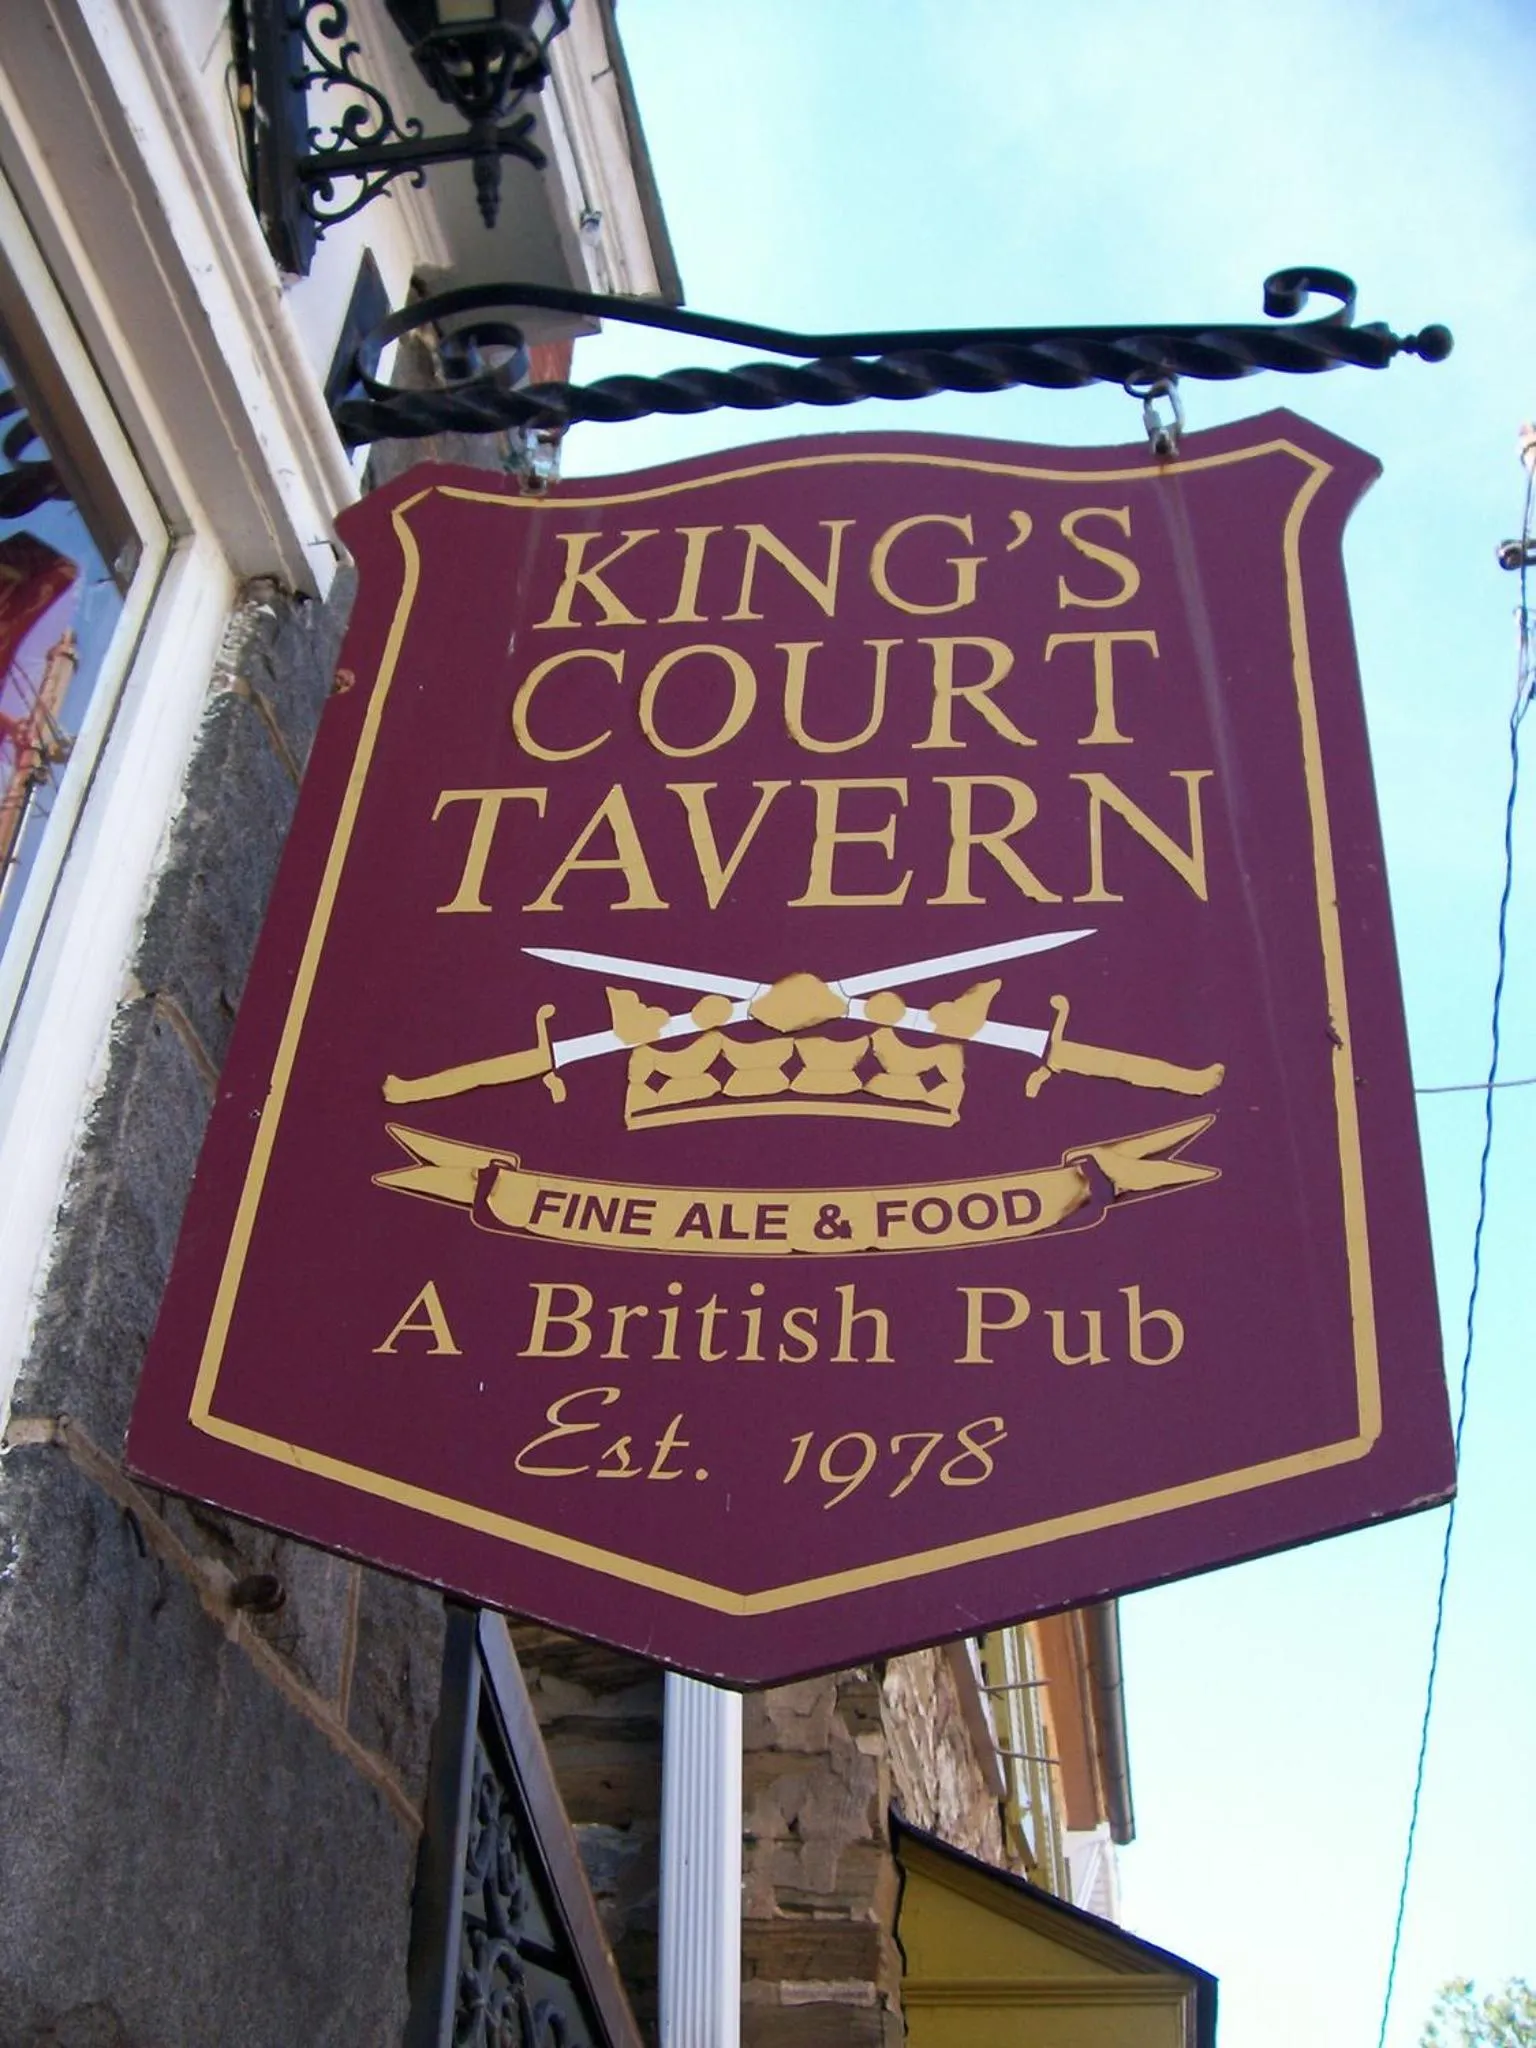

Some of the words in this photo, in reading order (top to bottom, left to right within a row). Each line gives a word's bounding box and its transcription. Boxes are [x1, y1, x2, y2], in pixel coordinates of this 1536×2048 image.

[532, 505, 1141, 629] KING'S
[512, 630, 1160, 762] COURT
[431, 769, 1214, 913] TAVERN
[529, 1189, 659, 1236] FINE
[675, 1203, 788, 1241] ALE
[813, 1203, 852, 1240] &
[876, 1187, 1044, 1239] FOOD
[372, 1280, 463, 1356] A
[517, 1281, 895, 1363] British
[954, 1284, 1185, 1366] Pub
[514, 1386, 709, 1481] Est.
[783, 1416, 1008, 1510] 1978
